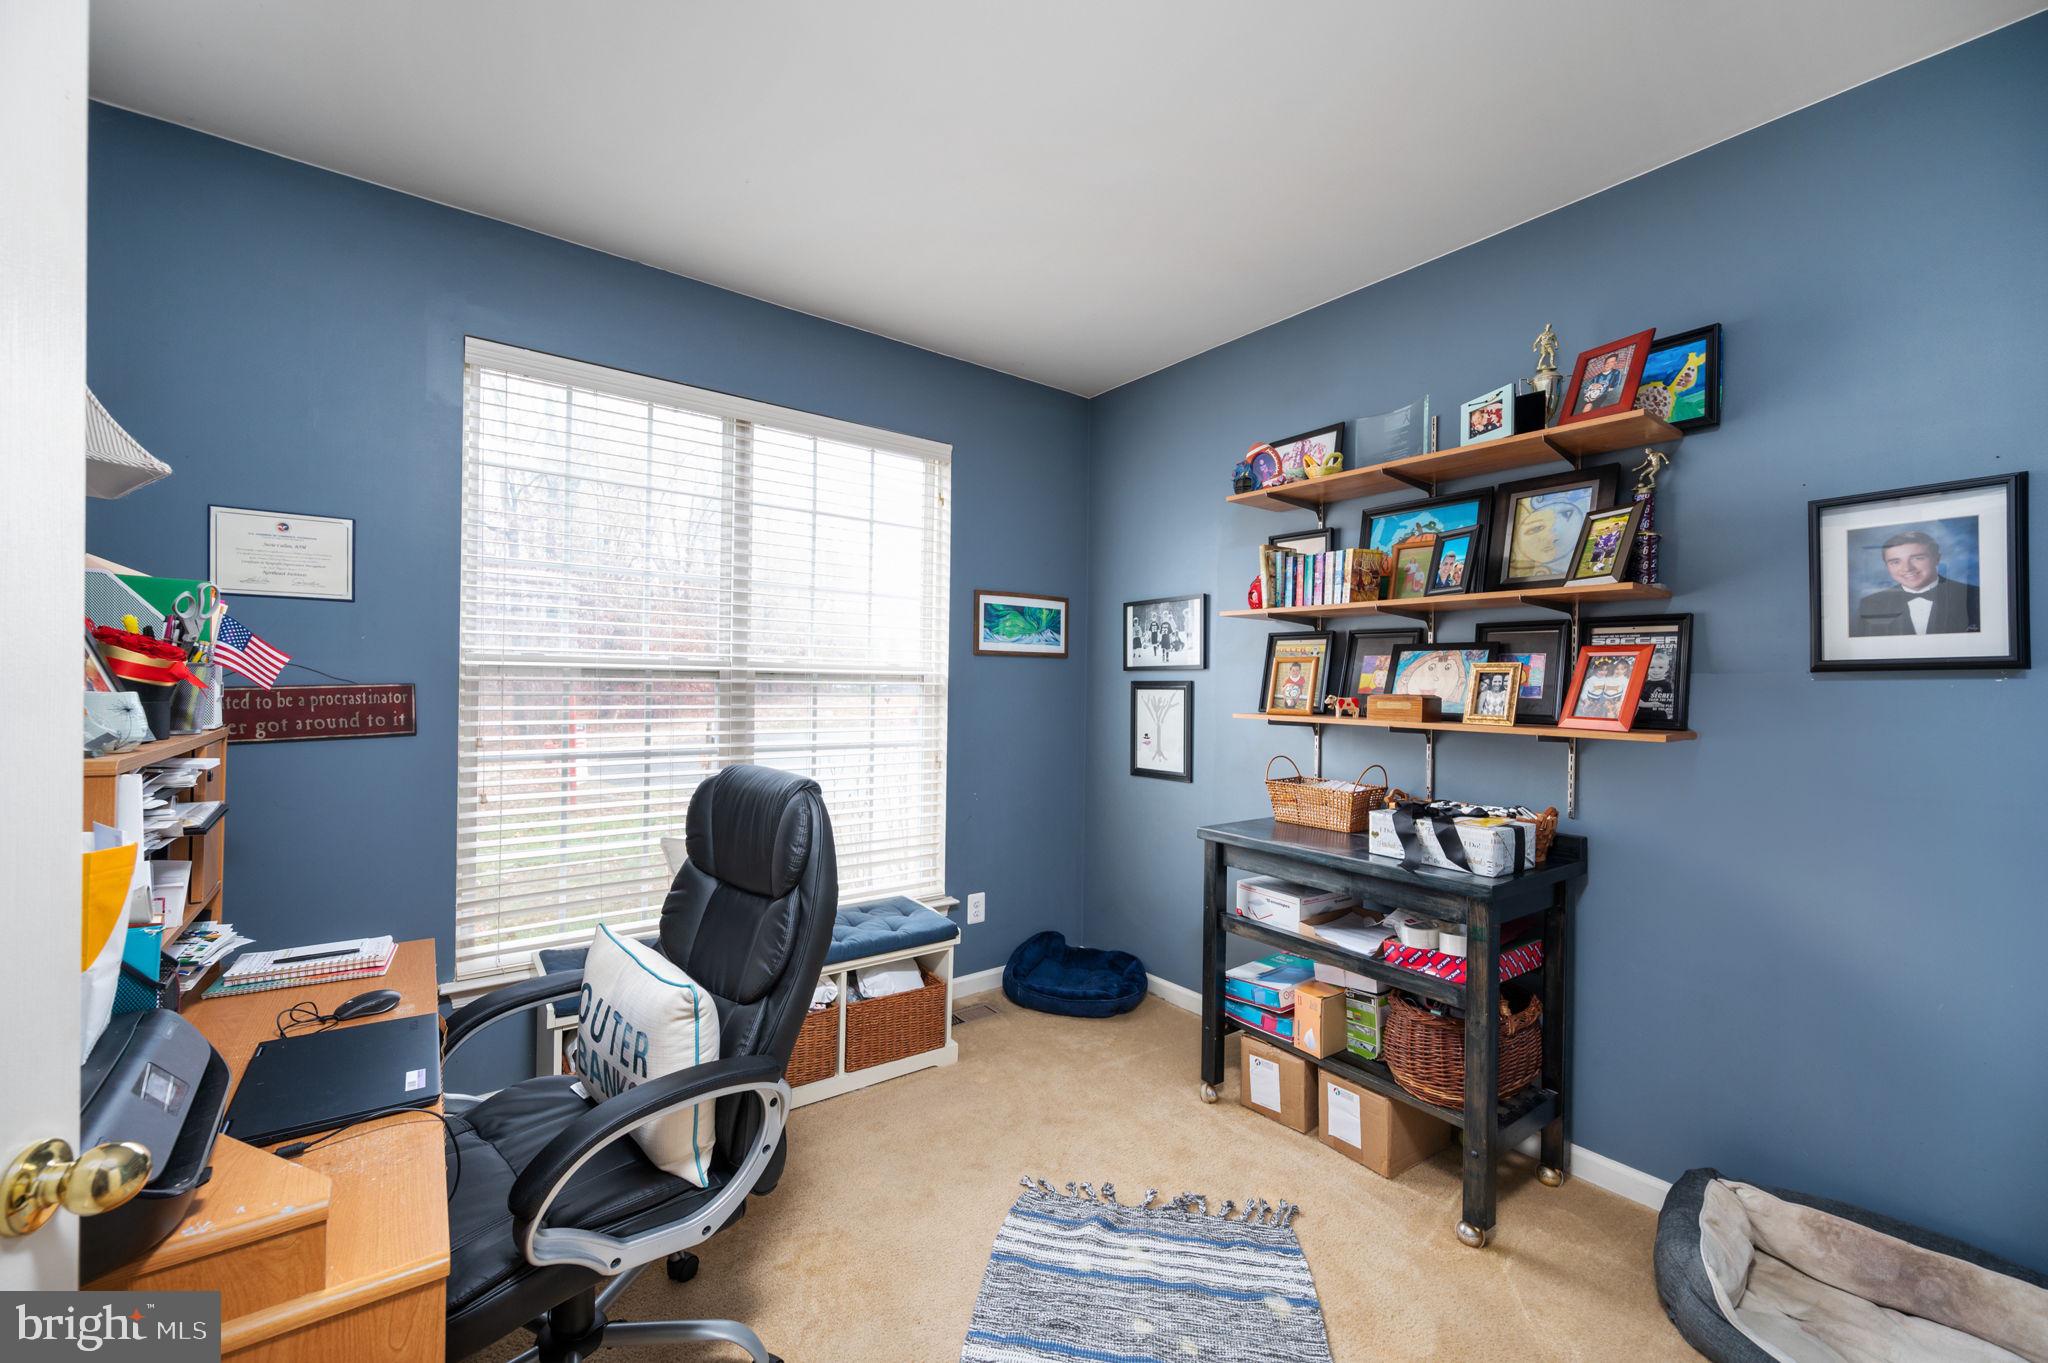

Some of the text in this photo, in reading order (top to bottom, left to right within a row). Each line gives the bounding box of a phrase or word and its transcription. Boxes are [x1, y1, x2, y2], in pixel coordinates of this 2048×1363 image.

[1591, 635, 1678, 646] SOCCER
[222, 688, 408, 713] ted to be a procrastinator
[255, 718, 289, 740] got
[295, 711, 360, 731] around
[367, 715, 386, 728] to
[393, 710, 406, 726] it
[579, 982, 650, 1079] OUTER
